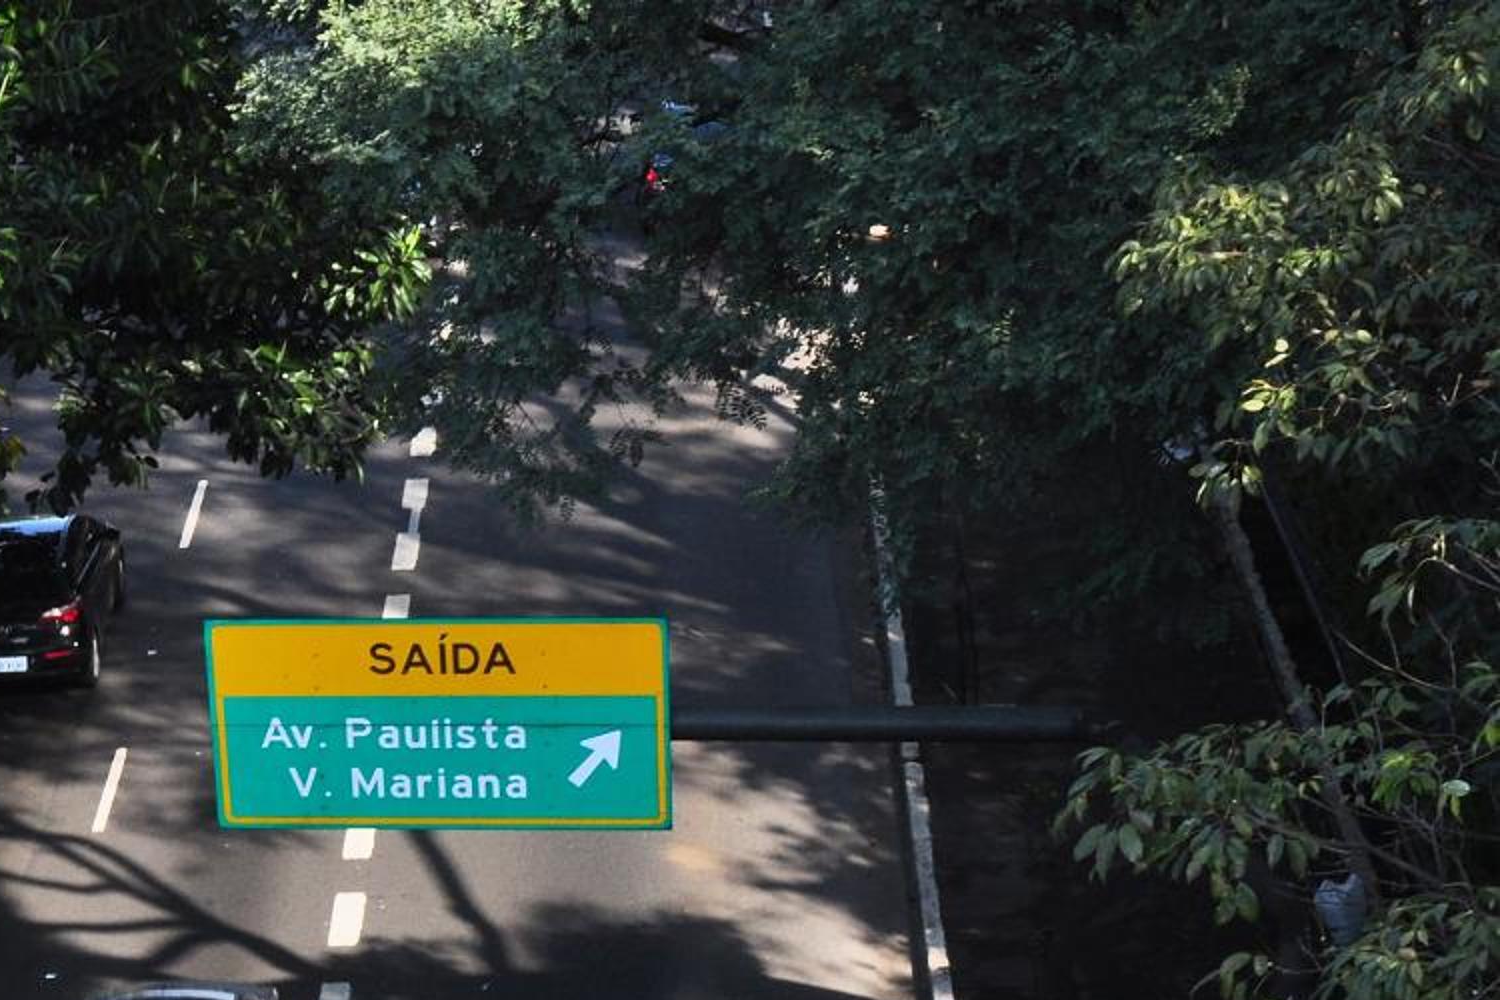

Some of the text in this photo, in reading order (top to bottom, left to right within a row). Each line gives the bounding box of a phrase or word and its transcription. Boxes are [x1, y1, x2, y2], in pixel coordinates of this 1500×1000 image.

[369, 634, 517, 676] SAÍDA
[262, 718, 527, 749] Av. Paulista
[290, 767, 528, 798] V. Mariana
